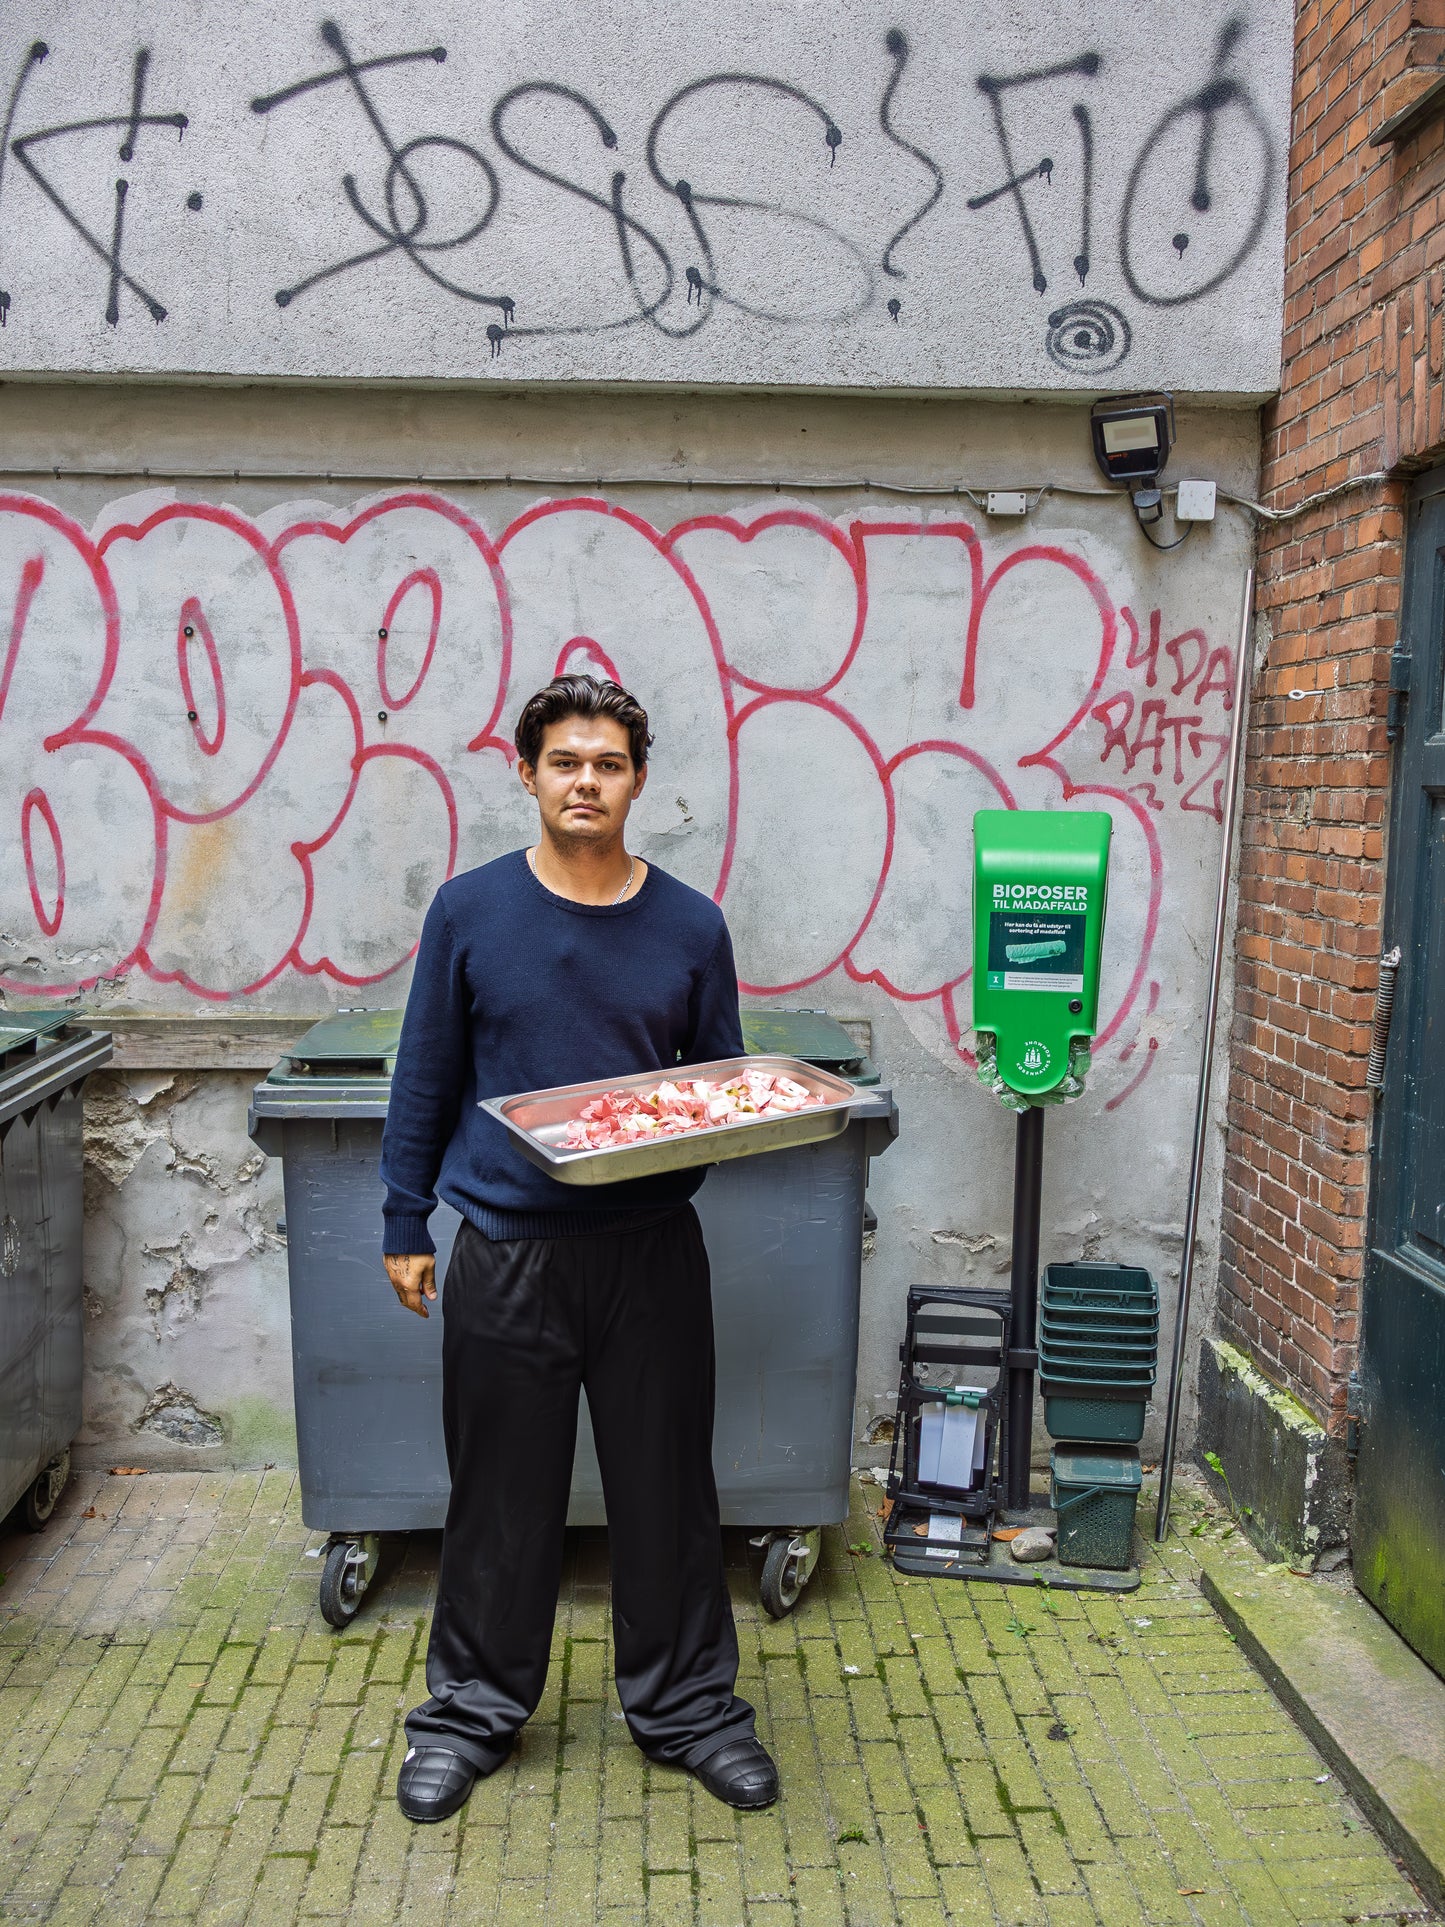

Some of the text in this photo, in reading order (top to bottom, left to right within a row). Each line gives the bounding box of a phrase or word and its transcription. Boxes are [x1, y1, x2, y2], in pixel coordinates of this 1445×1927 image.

[992, 884, 1088, 900] BIOPOSER
[992, 899, 1087, 911] TIL MADAFFALD
